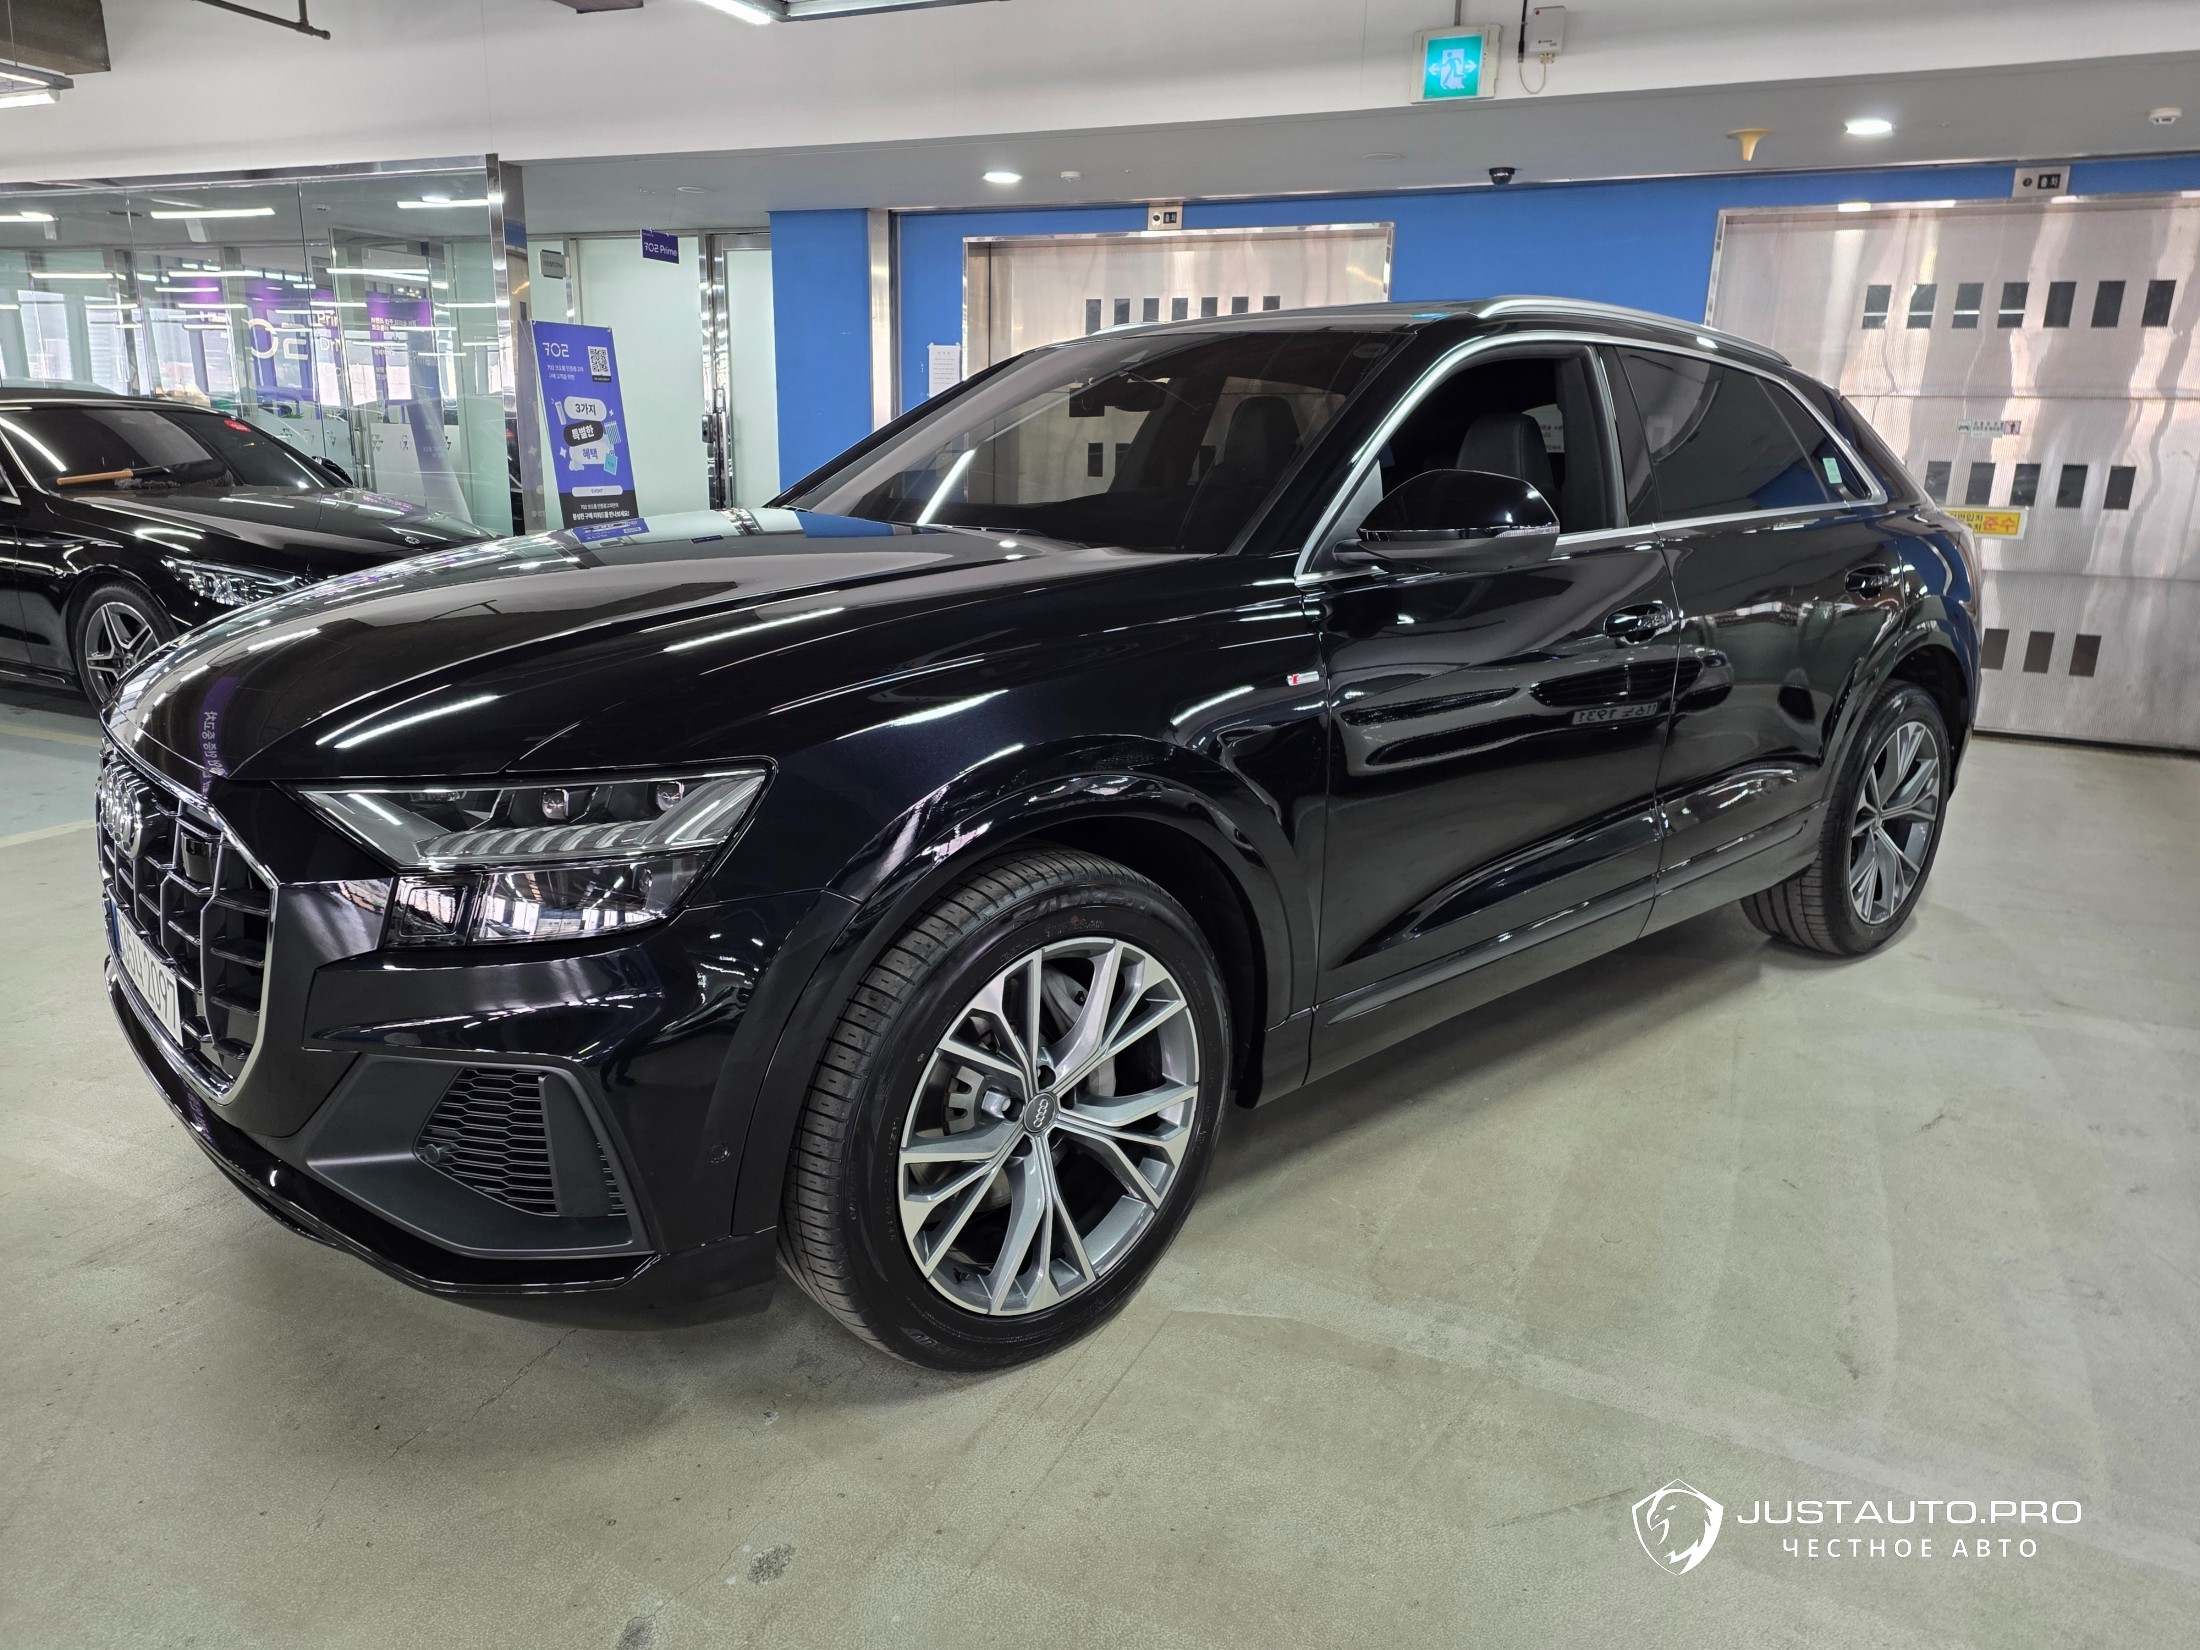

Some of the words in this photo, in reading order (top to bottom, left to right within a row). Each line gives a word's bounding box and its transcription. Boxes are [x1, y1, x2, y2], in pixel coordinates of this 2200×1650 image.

[660, 245, 678, 257] Prime
[542, 342, 570, 358] 702
[575, 402, 597, 416] 3가지
[571, 424, 595, 441] 특별한
[582, 447, 598, 460] 혜택
[1983, 516, 2016, 532] 준수
[143, 950, 176, 1029] 2097
